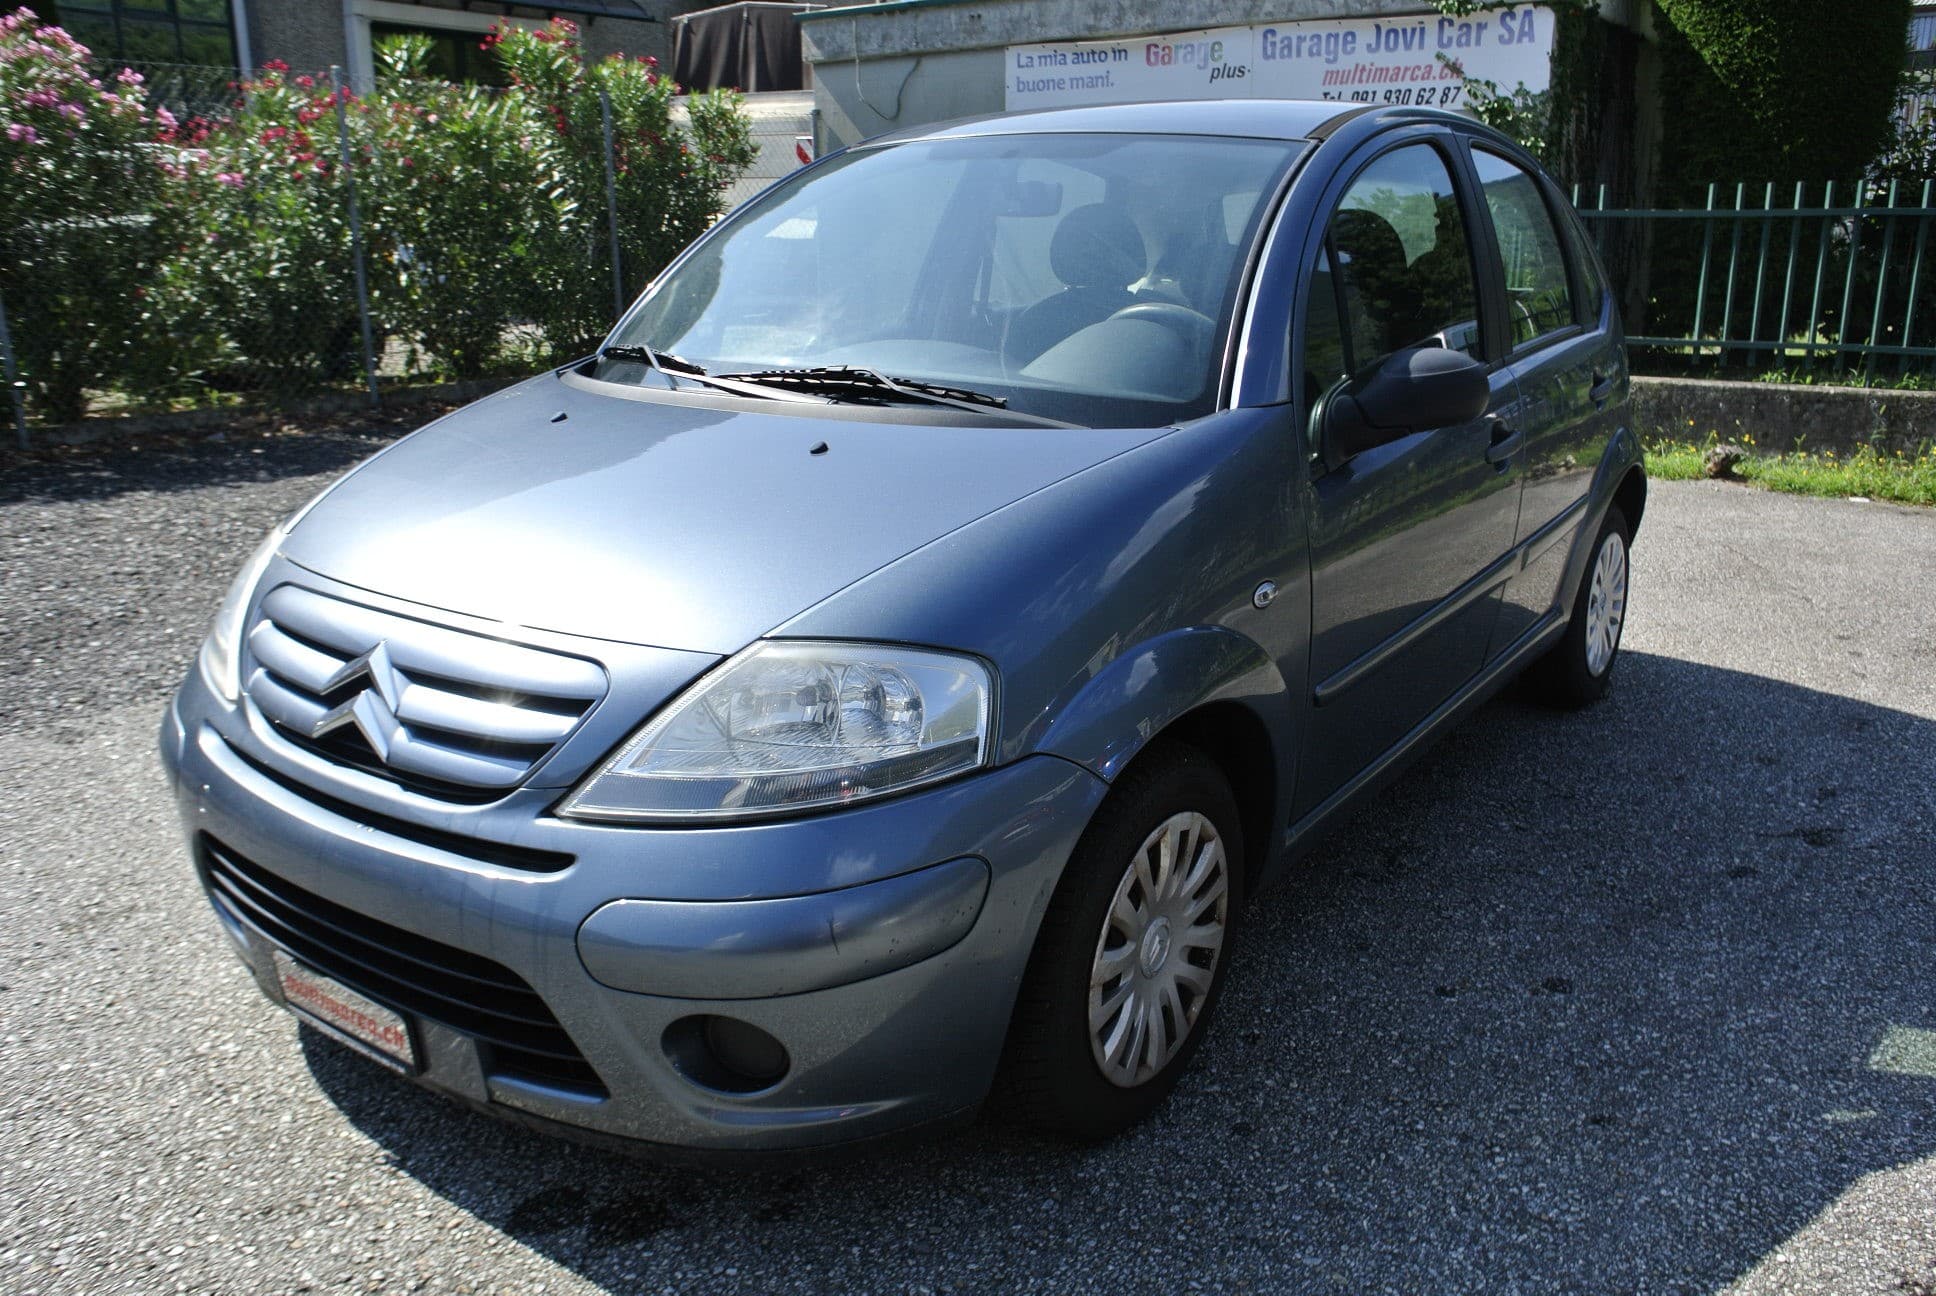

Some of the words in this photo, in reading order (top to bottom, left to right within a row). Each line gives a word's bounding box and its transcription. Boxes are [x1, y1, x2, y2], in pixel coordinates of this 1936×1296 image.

[1262, 28, 1357, 64] Garage
[1366, 21, 1426, 54] Jovi
[1437, 17, 1488, 49] Car
[1498, 9, 1535, 45] SA
[1016, 52, 1034, 69] La
[1038, 49, 1067, 67] mia
[1071, 49, 1108, 66] auto
[1112, 46, 1128, 63] in
[1145, 40, 1224, 70] Garage
[1016, 77, 1065, 93] buone
[1069, 70, 1115, 89] mani.
[1209, 62, 1246, 83] plus
[1322, 56, 1464, 86] multimarca.ch
[1383, 88, 1412, 105] 930
[1415, 86, 1437, 105] 62
[1440, 85, 1462, 105] 87
